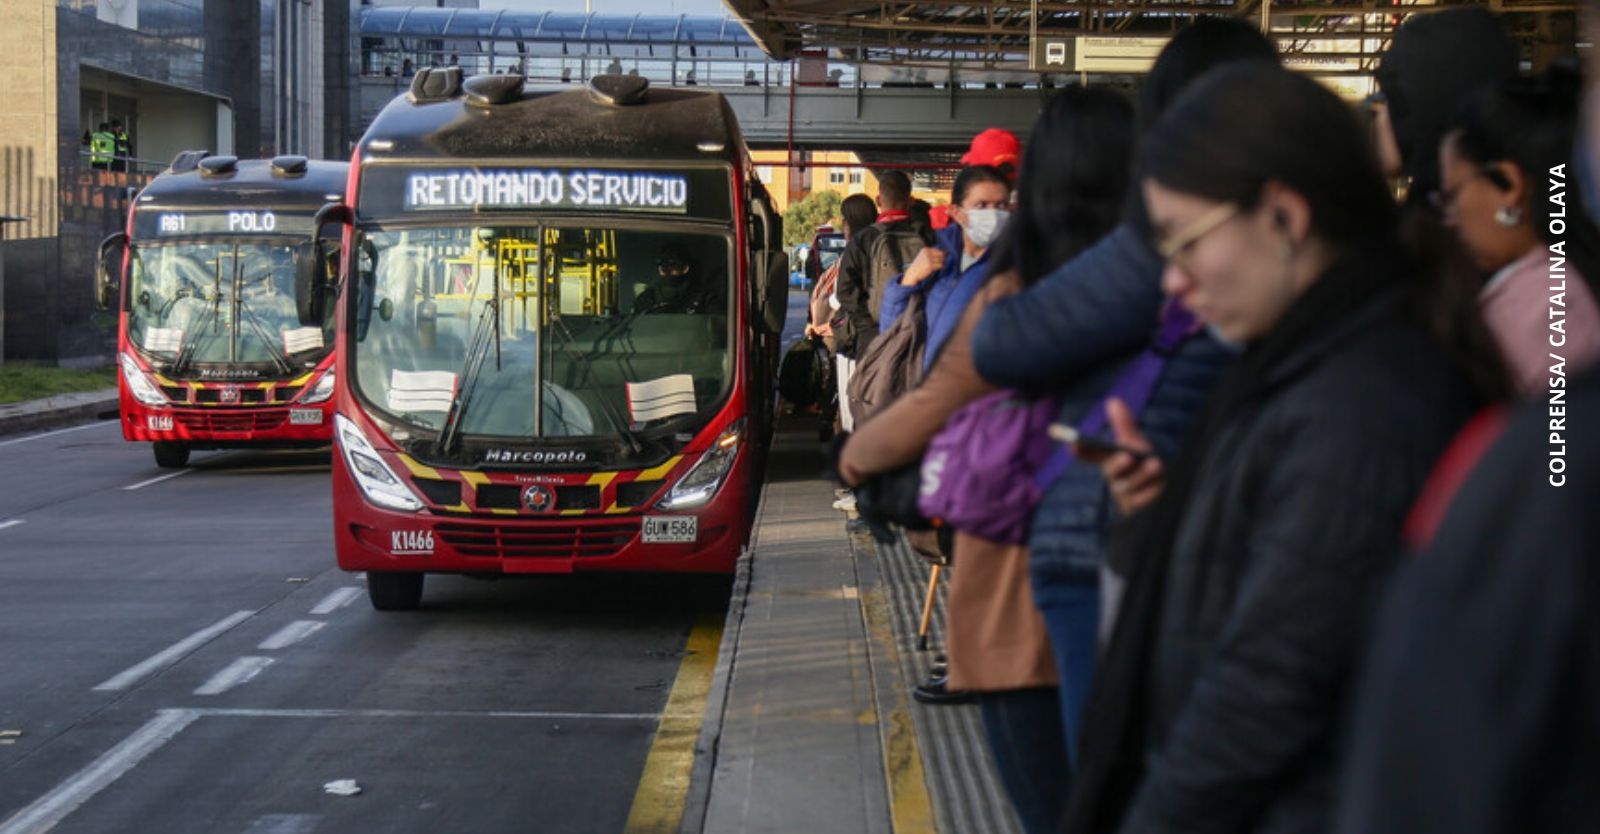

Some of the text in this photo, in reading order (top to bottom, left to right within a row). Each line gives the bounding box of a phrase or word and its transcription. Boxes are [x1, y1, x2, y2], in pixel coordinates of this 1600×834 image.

[410, 172, 687, 207] RETOMANDO SERVICIO
[228, 211, 275, 231] POLO
[485, 449, 587, 464] Marcopolo
[391, 530, 434, 550] K1466
